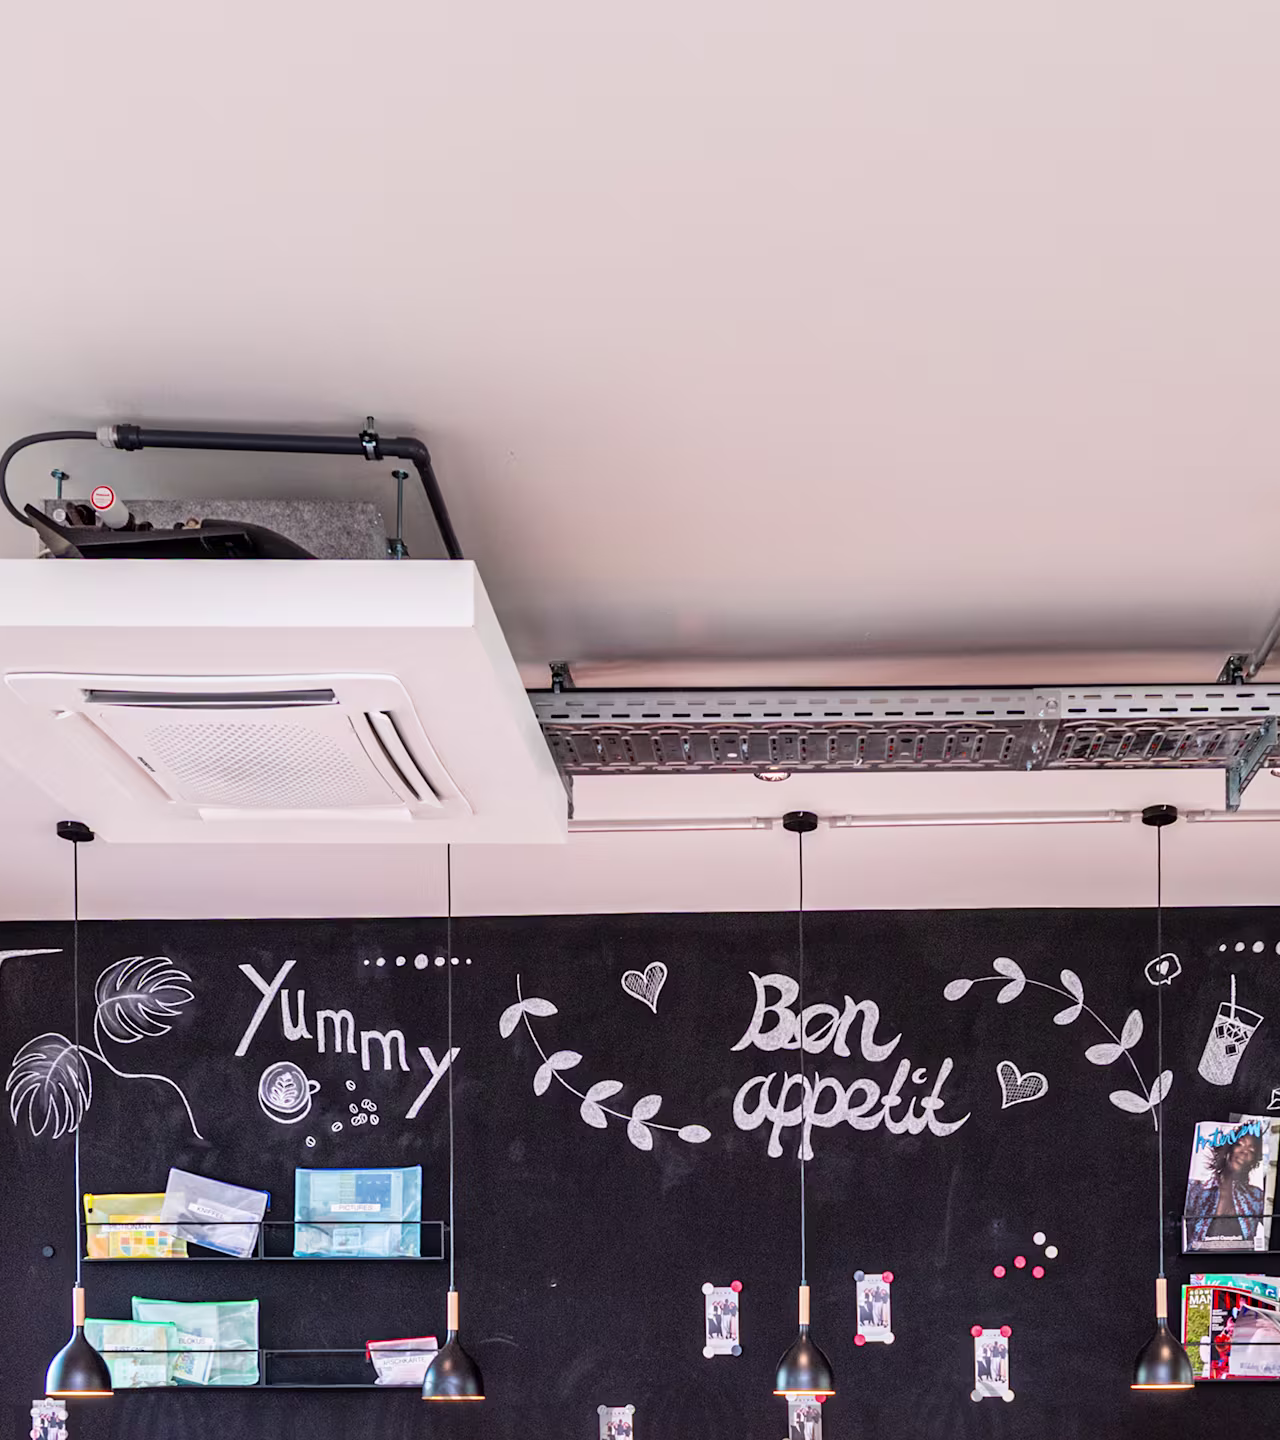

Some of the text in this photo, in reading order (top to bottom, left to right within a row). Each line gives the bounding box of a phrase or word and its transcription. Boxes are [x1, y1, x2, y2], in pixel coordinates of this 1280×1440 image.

[234, 959, 460, 1119] Yummy
[730, 971, 902, 1062] Bon
[732, 1057, 971, 1161] appetit
[1195, 1120, 1261, 1153] Interview
